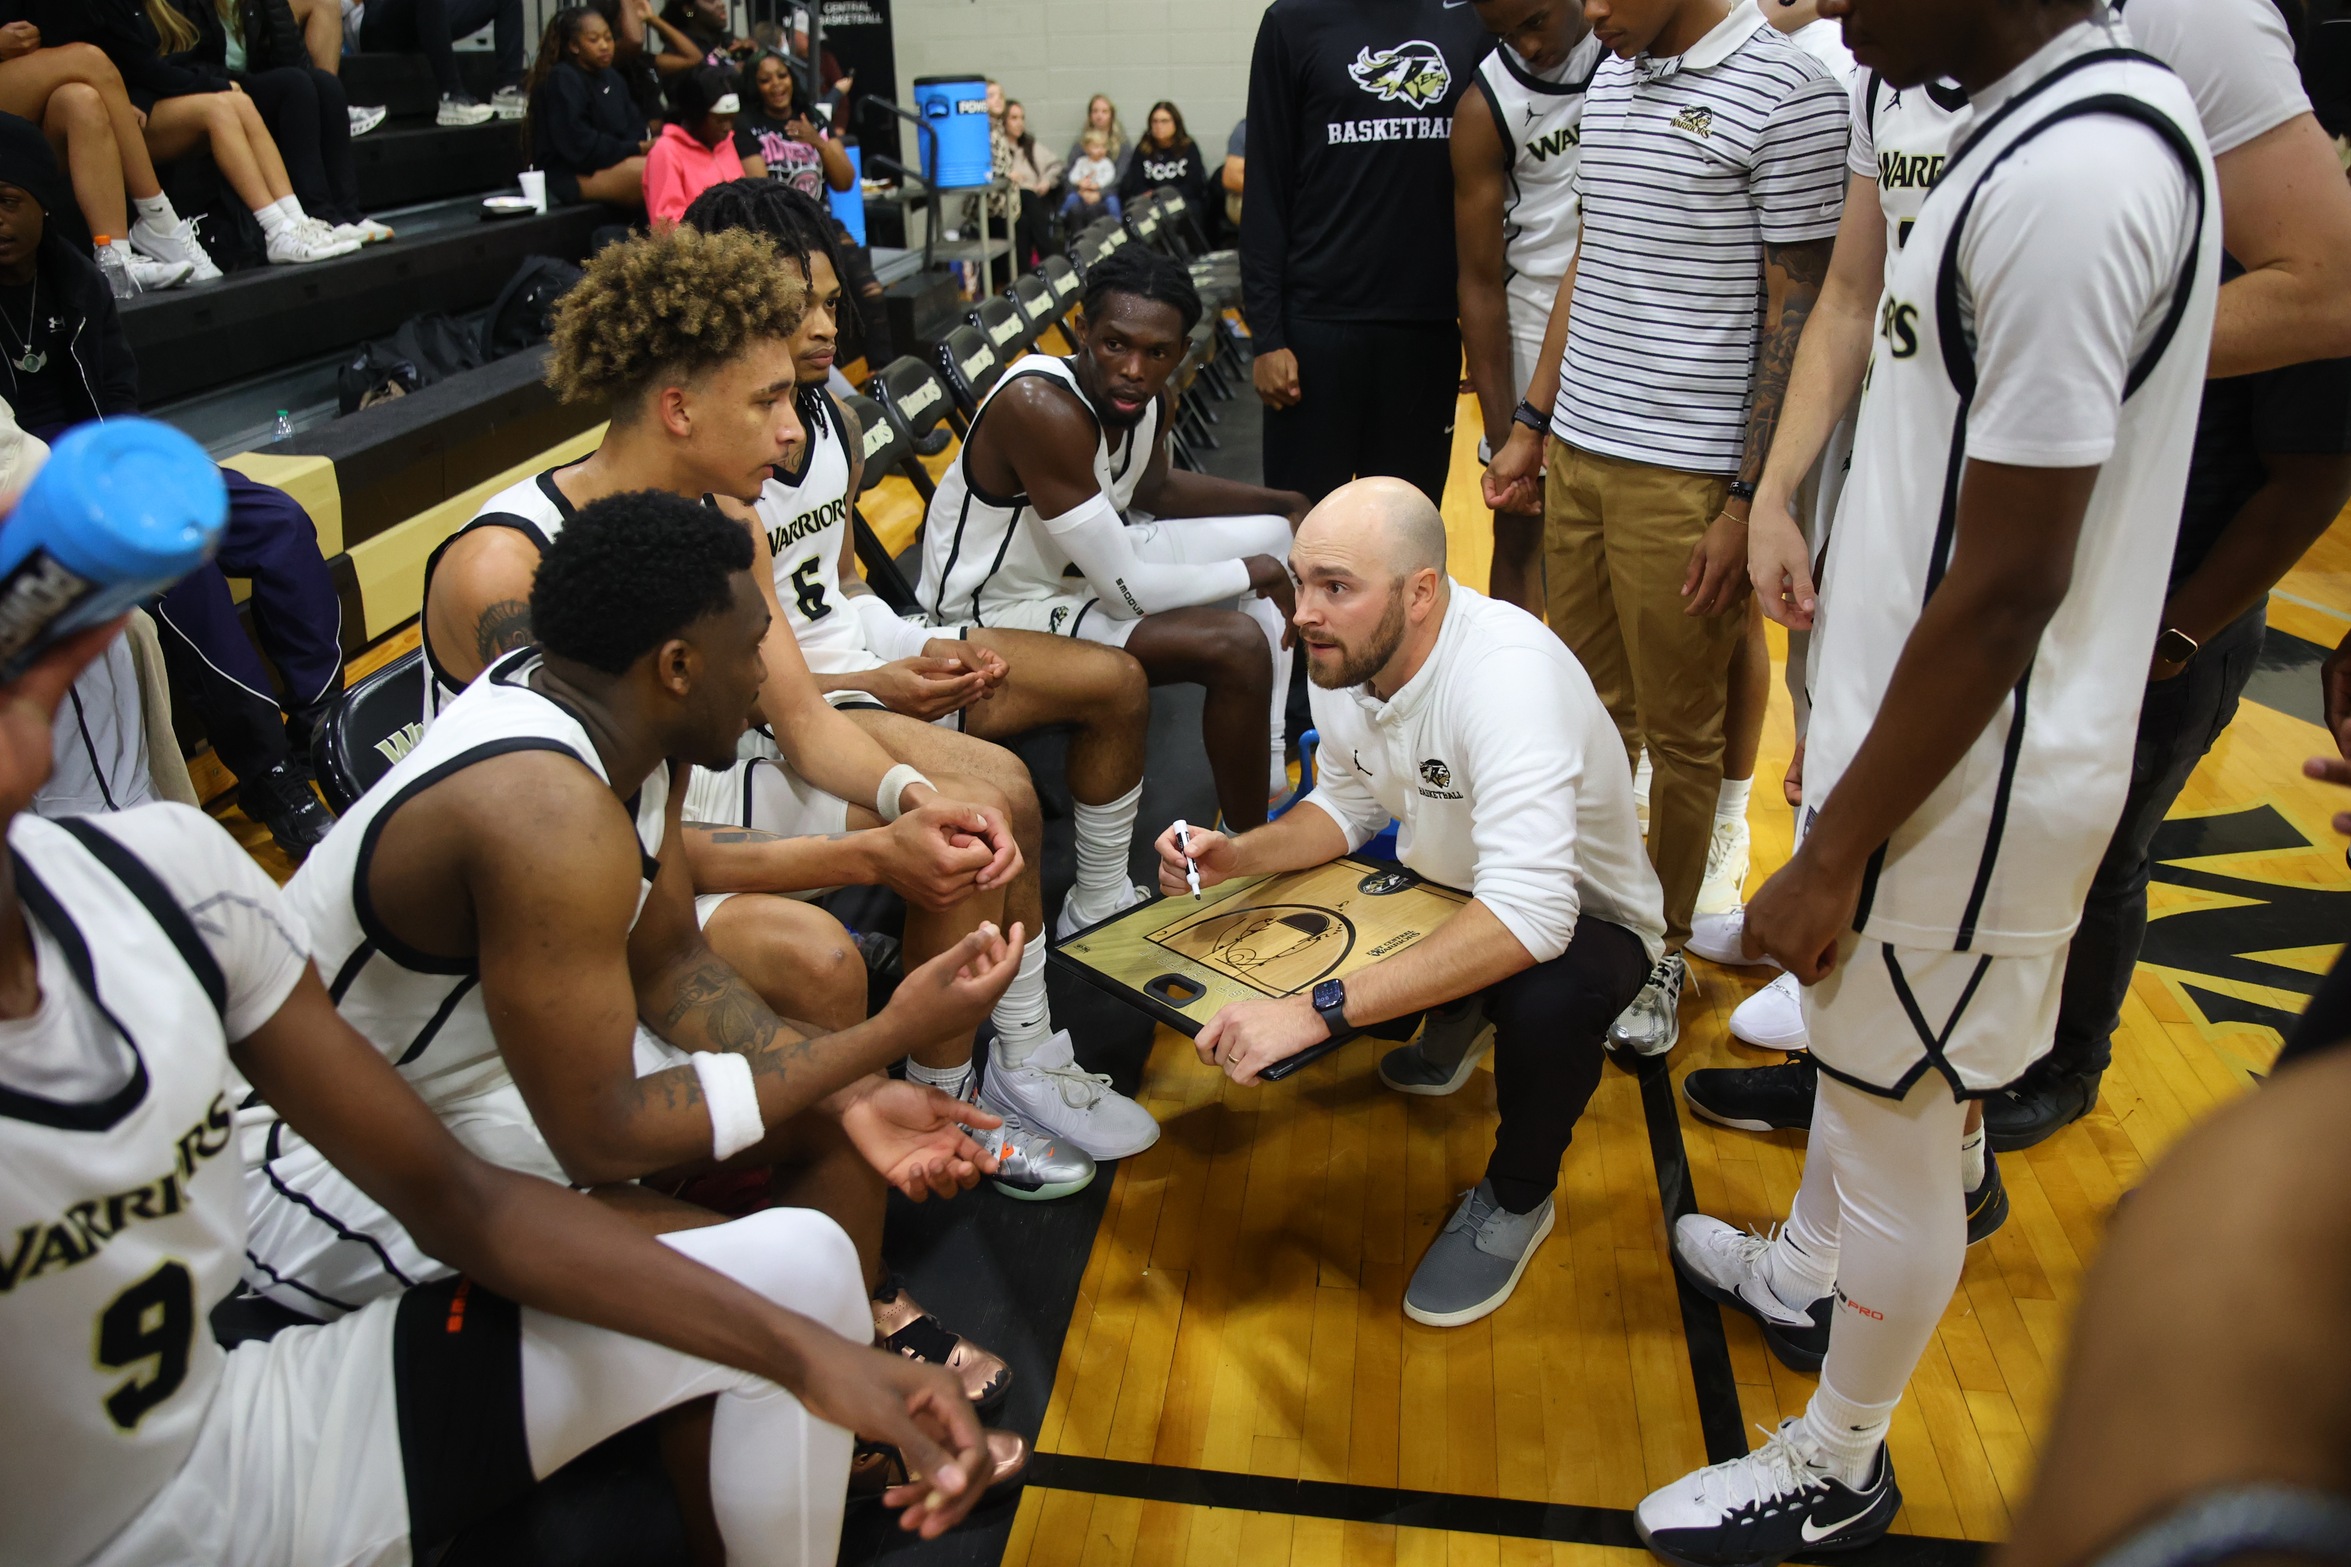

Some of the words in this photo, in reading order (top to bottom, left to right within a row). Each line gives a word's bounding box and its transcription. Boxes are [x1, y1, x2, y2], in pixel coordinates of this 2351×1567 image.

[1526, 122, 1581, 162] WA
[1669, 117, 1712, 140] WARRIORS
[791, 553, 832, 622] 6
[1847, 1299, 1884, 1321] PRO
[94, 1257, 196, 1435] 9
